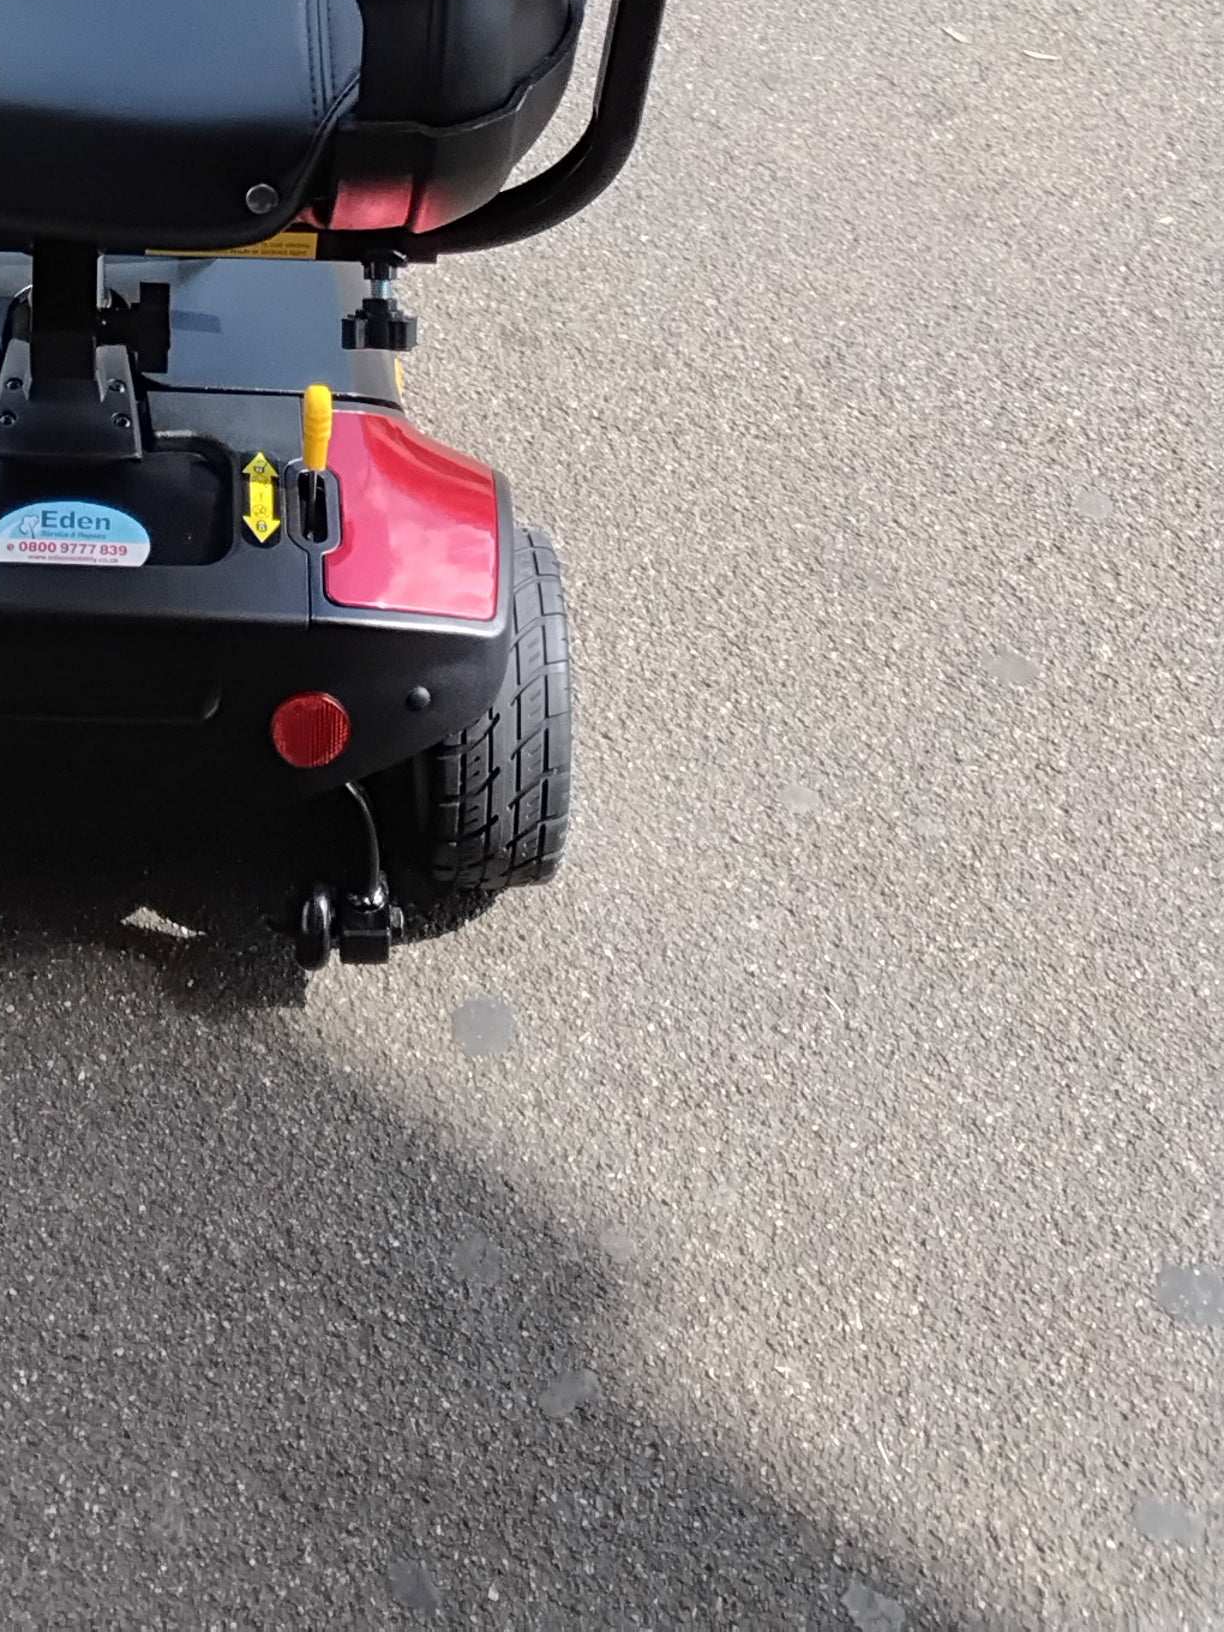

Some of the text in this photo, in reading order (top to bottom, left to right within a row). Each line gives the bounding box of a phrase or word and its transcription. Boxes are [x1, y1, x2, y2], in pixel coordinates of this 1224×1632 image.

[41, 510, 111, 530] Eden
[19, 541, 128, 556] 0800 9777 839
